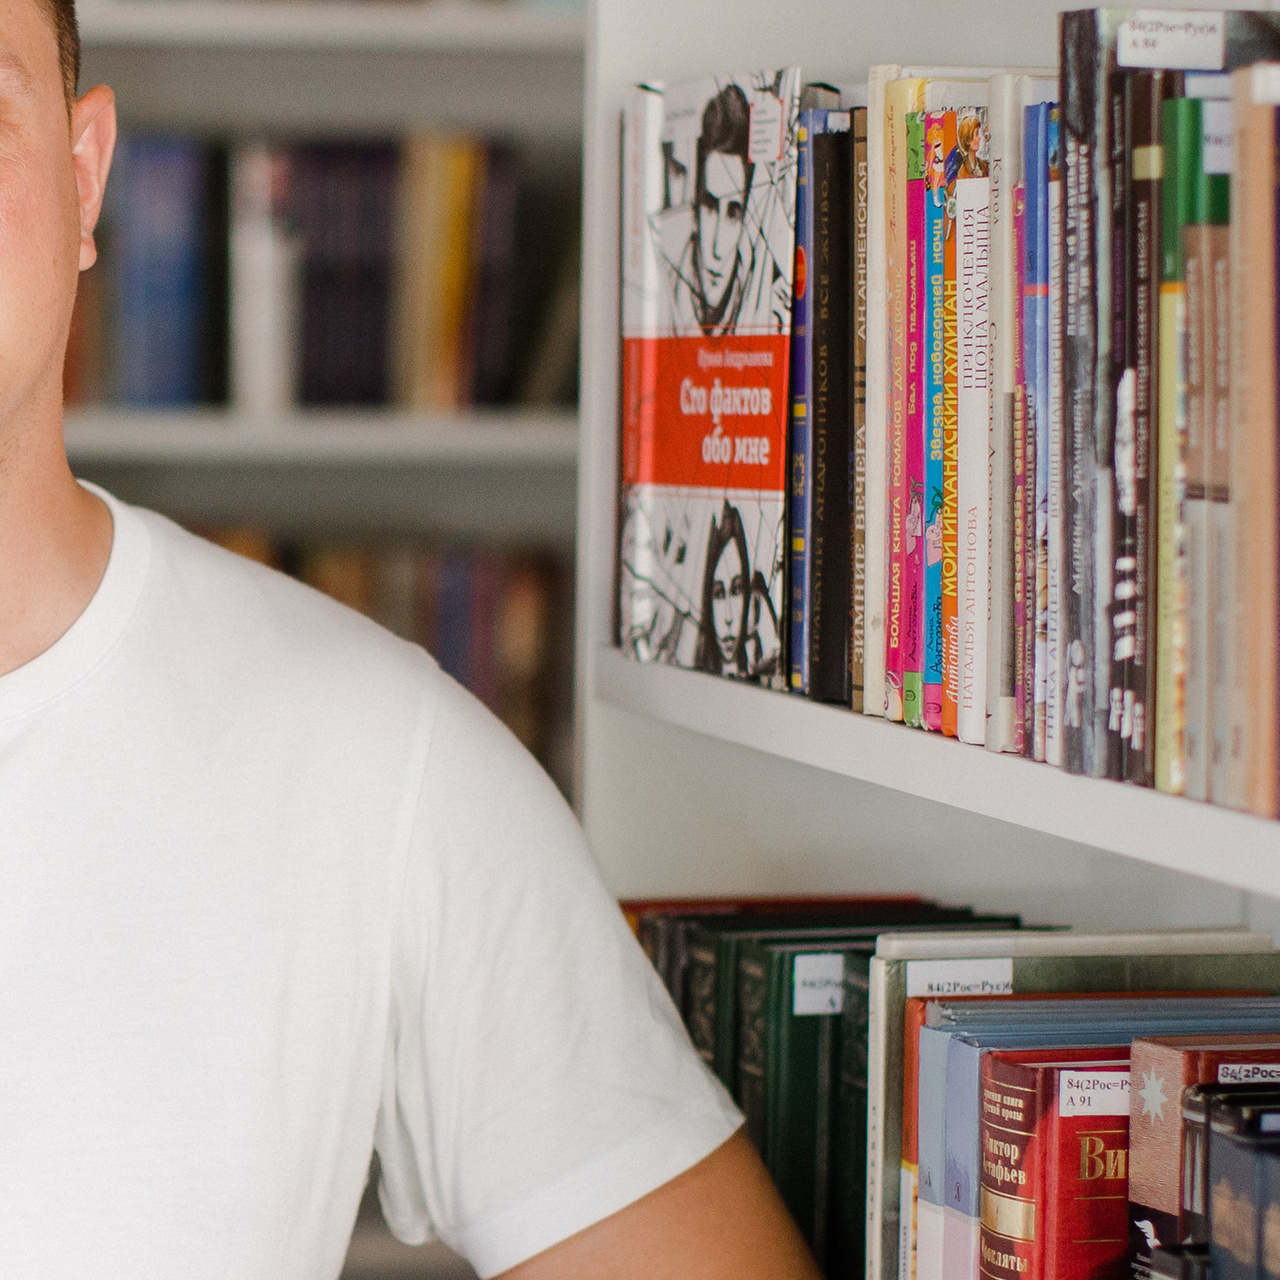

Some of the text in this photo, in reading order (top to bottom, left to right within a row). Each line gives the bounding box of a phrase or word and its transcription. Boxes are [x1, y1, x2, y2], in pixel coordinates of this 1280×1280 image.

[991, 156, 1002, 226] Кэрол
[908, 240, 918, 415] Бал под пальмами
[943, 278, 958, 377] ХУЛИГАН
[962, 207, 975, 390] ПРИКЛЮЧЕНИЯ
[974, 204, 989, 390] ШОНА МАЛЫША
[1066, 235, 1077, 336] Легенда об
[931, 219, 943, 461] Звезда новогодней ночи
[680, 377, 772, 425] Сто фактов
[702, 425, 770, 466] обо мне
[815, 345, 827, 521] АНДРОНИКОВ
[853, 425, 866, 532] ВЕЧЕРА
[890, 266, 903, 650] БОЛЬШАЯ КНИГА РОМАНОВ ДЛЯ ДЕВОЧЕК
[853, 543, 865, 665] ЗИМНИЕ
[1071, 514, 1083, 595] Марина
[962, 504, 978, 710] НАТАЛЬЯ АНТОНОВА
[945, 616, 958, 704] Антонова
[1001, 1107, 1024, 1121] прозы
[1002, 1094, 1024, 1109] книга
[1066, 1096, 1093, 1107] А 91
[1220, 1066, 1280, 1081] 84(2Рос=
[1077, 1134, 1128, 1181] Ви
